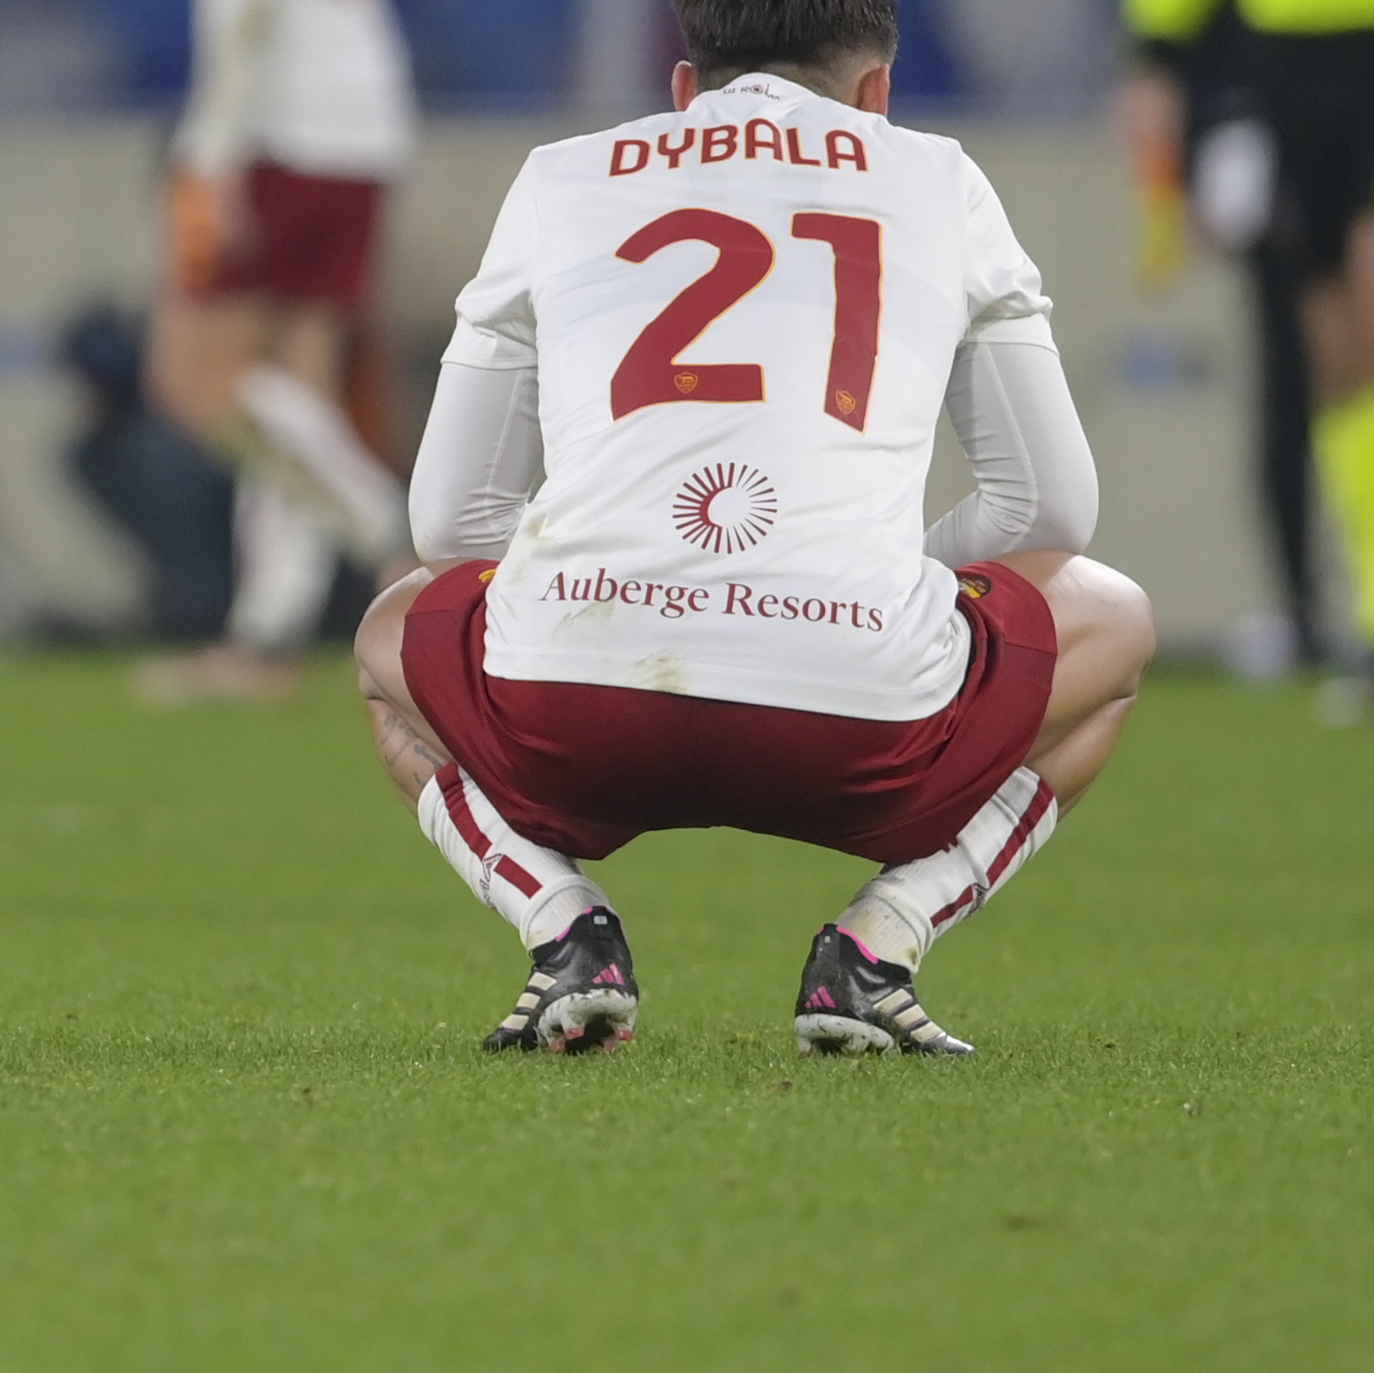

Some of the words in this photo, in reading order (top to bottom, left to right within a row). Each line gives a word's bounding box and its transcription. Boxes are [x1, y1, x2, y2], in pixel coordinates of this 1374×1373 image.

[608, 118, 869, 177] DYBALA
[610, 207, 883, 435] 21
[539, 568, 710, 619] Auberge
[721, 582, 884, 632] Resorts
